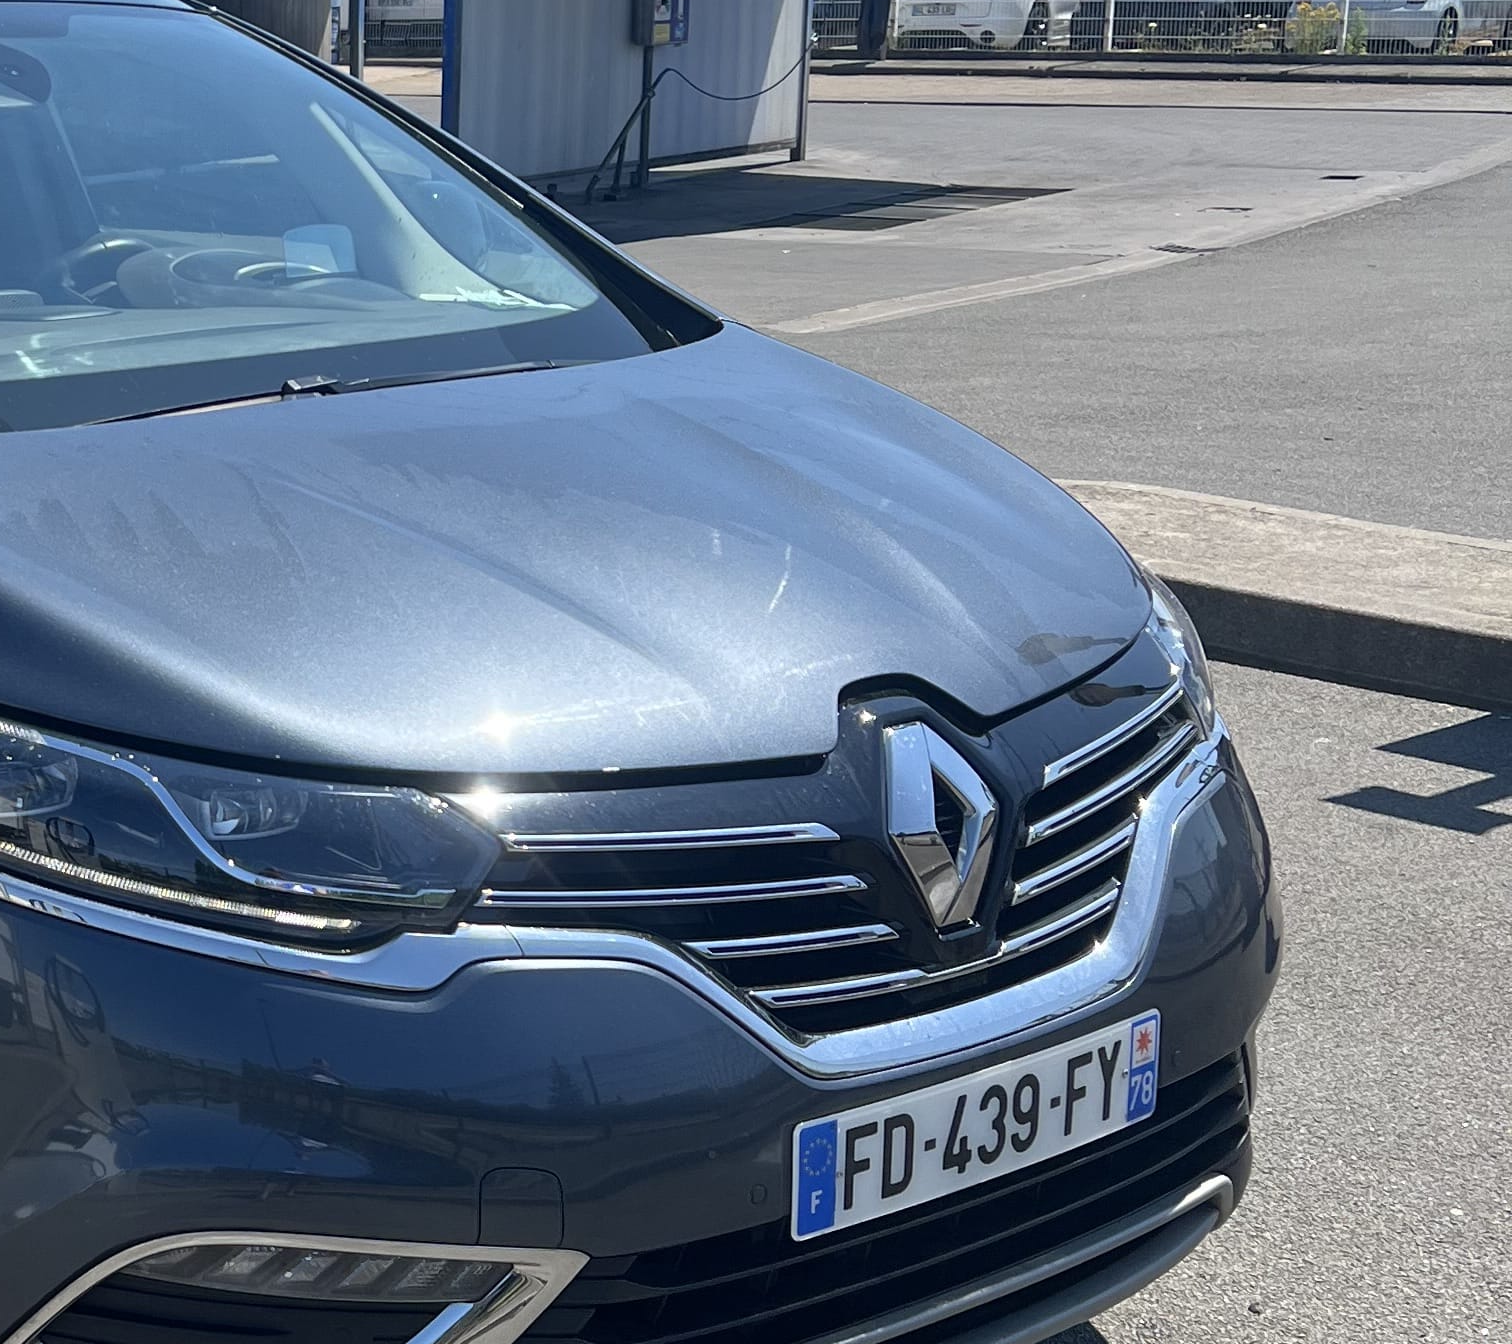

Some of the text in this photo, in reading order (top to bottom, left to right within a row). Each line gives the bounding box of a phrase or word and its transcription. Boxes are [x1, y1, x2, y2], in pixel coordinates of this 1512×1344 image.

[1129, 1070, 1154, 1111] 78
[843, 1040, 1123, 1210] FD-439-FY
[811, 1189, 823, 1214] F
